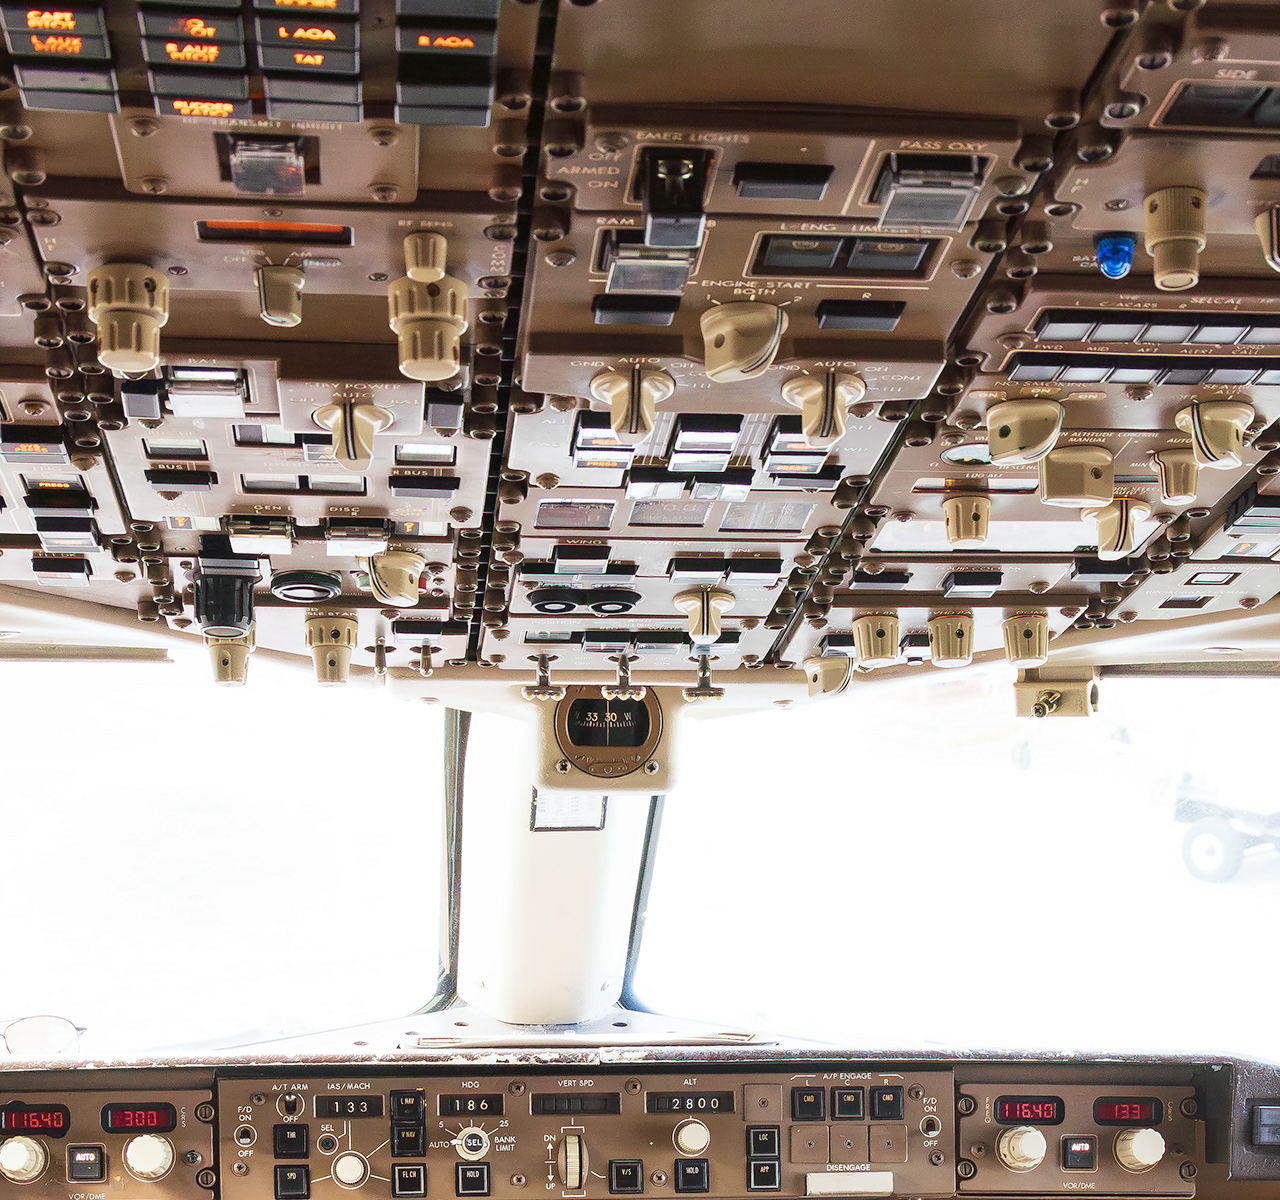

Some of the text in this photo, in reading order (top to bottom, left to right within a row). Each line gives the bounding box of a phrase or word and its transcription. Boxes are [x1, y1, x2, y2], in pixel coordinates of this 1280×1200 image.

[293, 54, 324, 65] TAT
[702, 280, 810, 289] ENGINE START
[734, 287, 776, 296] BOTH
[327, 1082, 371, 1090] IAS/MACH
[683, 1078, 697, 1086] ALT
[272, 1083, 308, 1091] A/T ARM
[672, 1098, 719, 1110] 2800
[238, 1106, 252, 1114] F/D
[1005, 1104, 1054, 1118] 116.40
[11, 1112, 63, 1129] 116.40
[124, 1111, 156, 1126] 300
[283, 1115, 298, 1123] OFF
[467, 1138, 483, 1146] SEL
[494, 1136, 516, 1144] BANK
[544, 1134, 556, 1142] DN
[1072, 1143, 1090, 1151] AUTO
[76, 1153, 94, 1161] AUTO
[546, 1182, 556, 1190] UP
